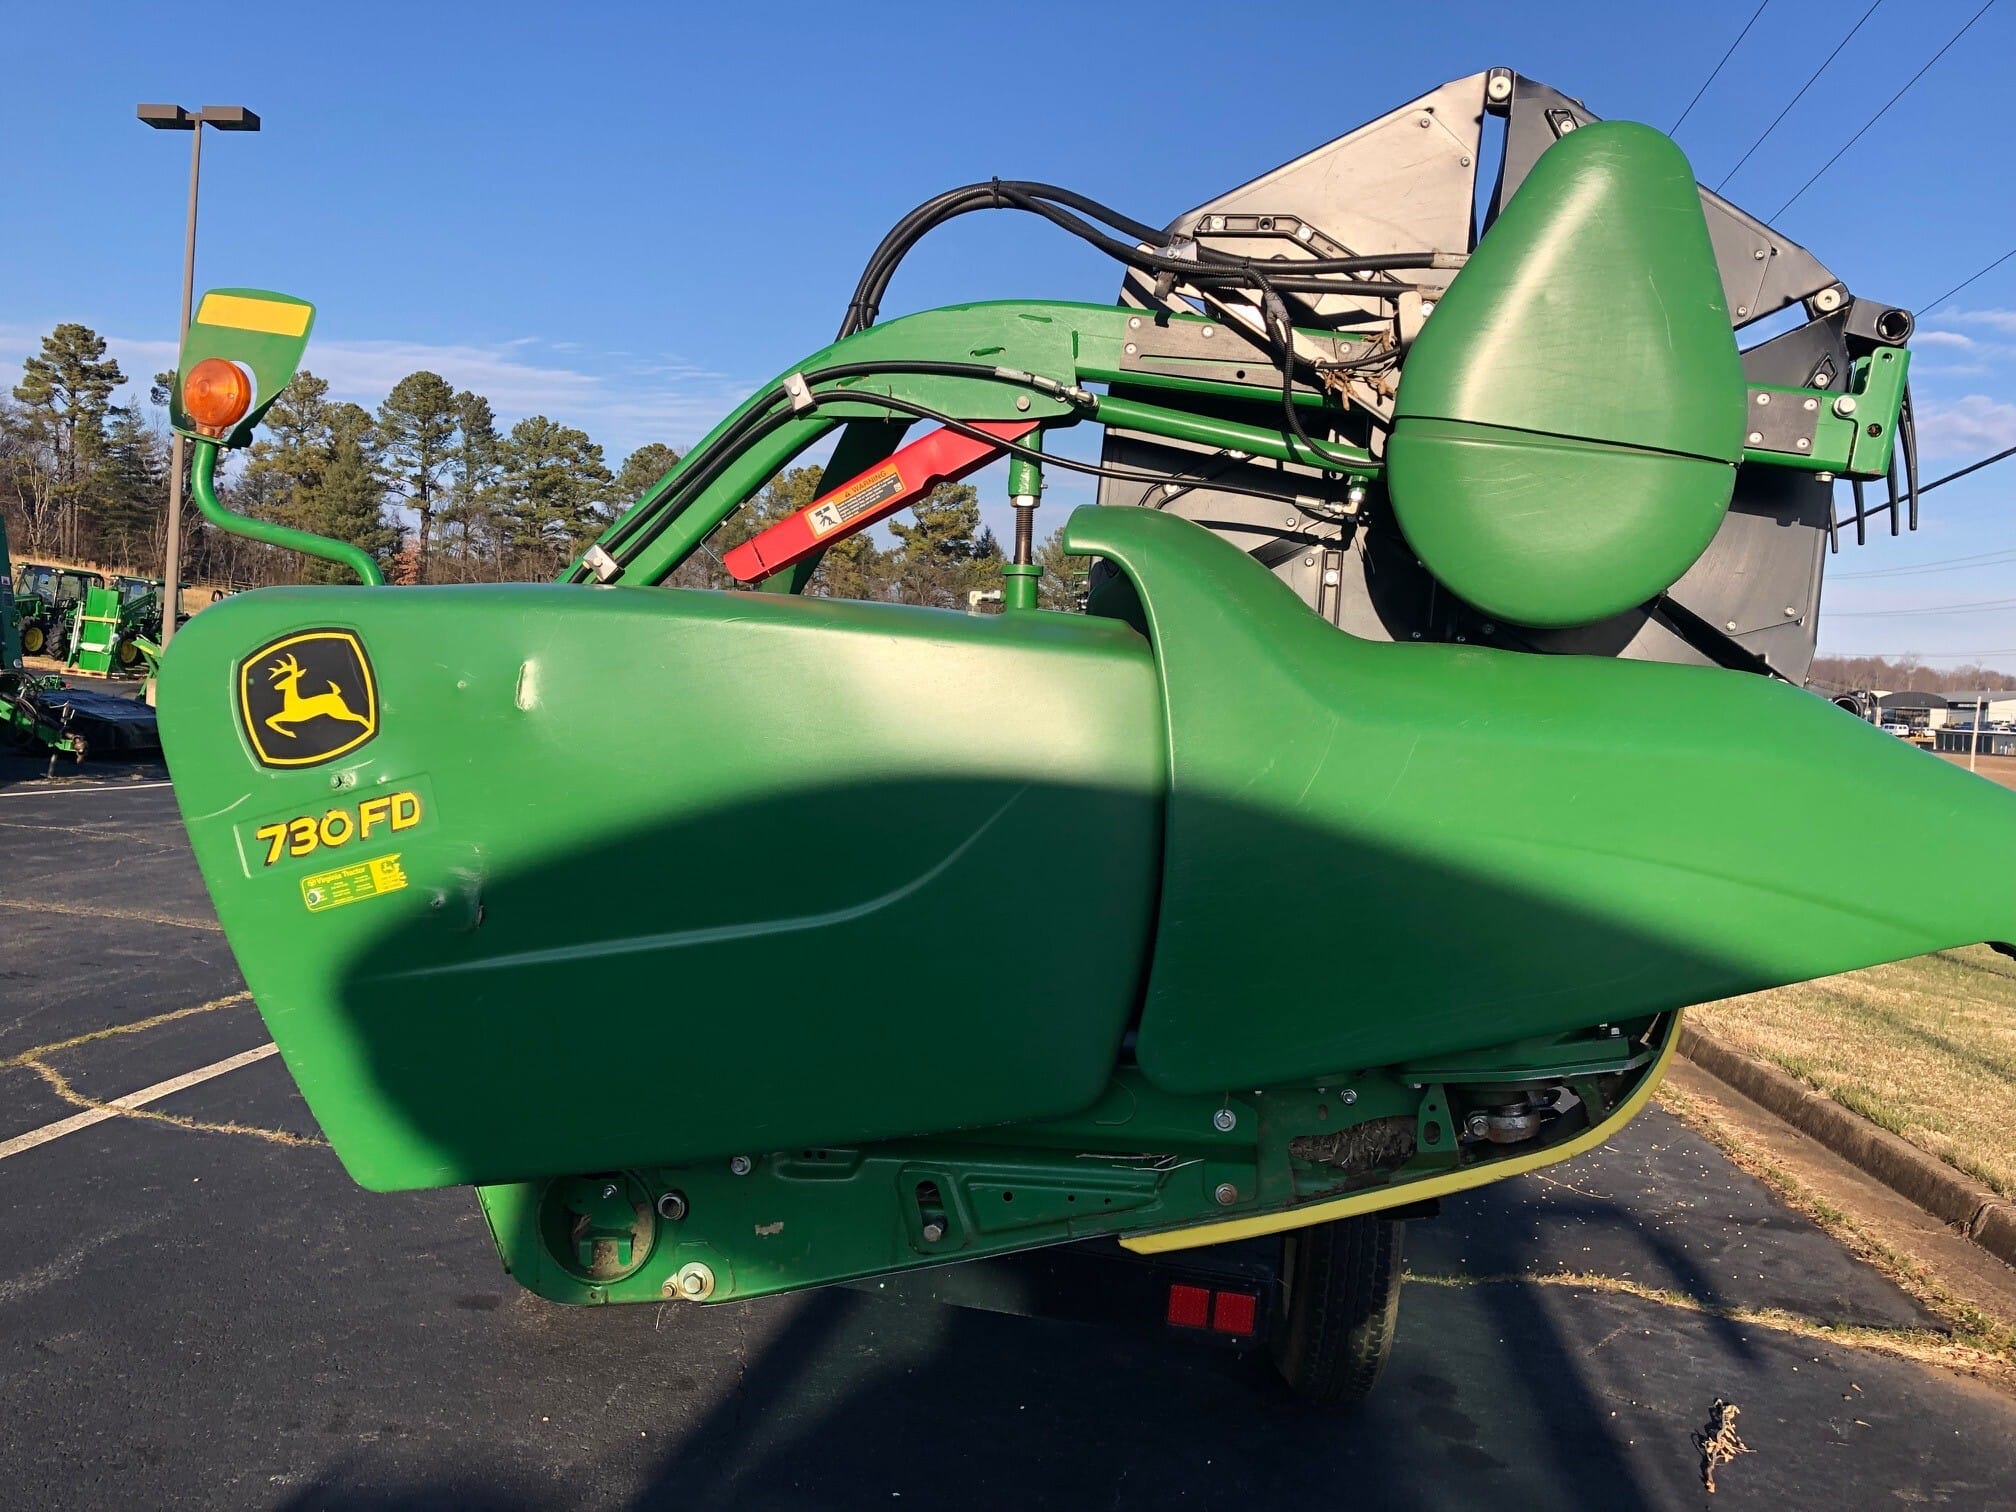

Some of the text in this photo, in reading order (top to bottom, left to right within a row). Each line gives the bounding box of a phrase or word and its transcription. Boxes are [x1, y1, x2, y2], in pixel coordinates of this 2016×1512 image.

[851, 470, 887, 493] WARNING
[255, 791, 421, 867] 730 FD
[315, 873, 342, 885] Virginia
[341, 867, 366, 877] Tractor
